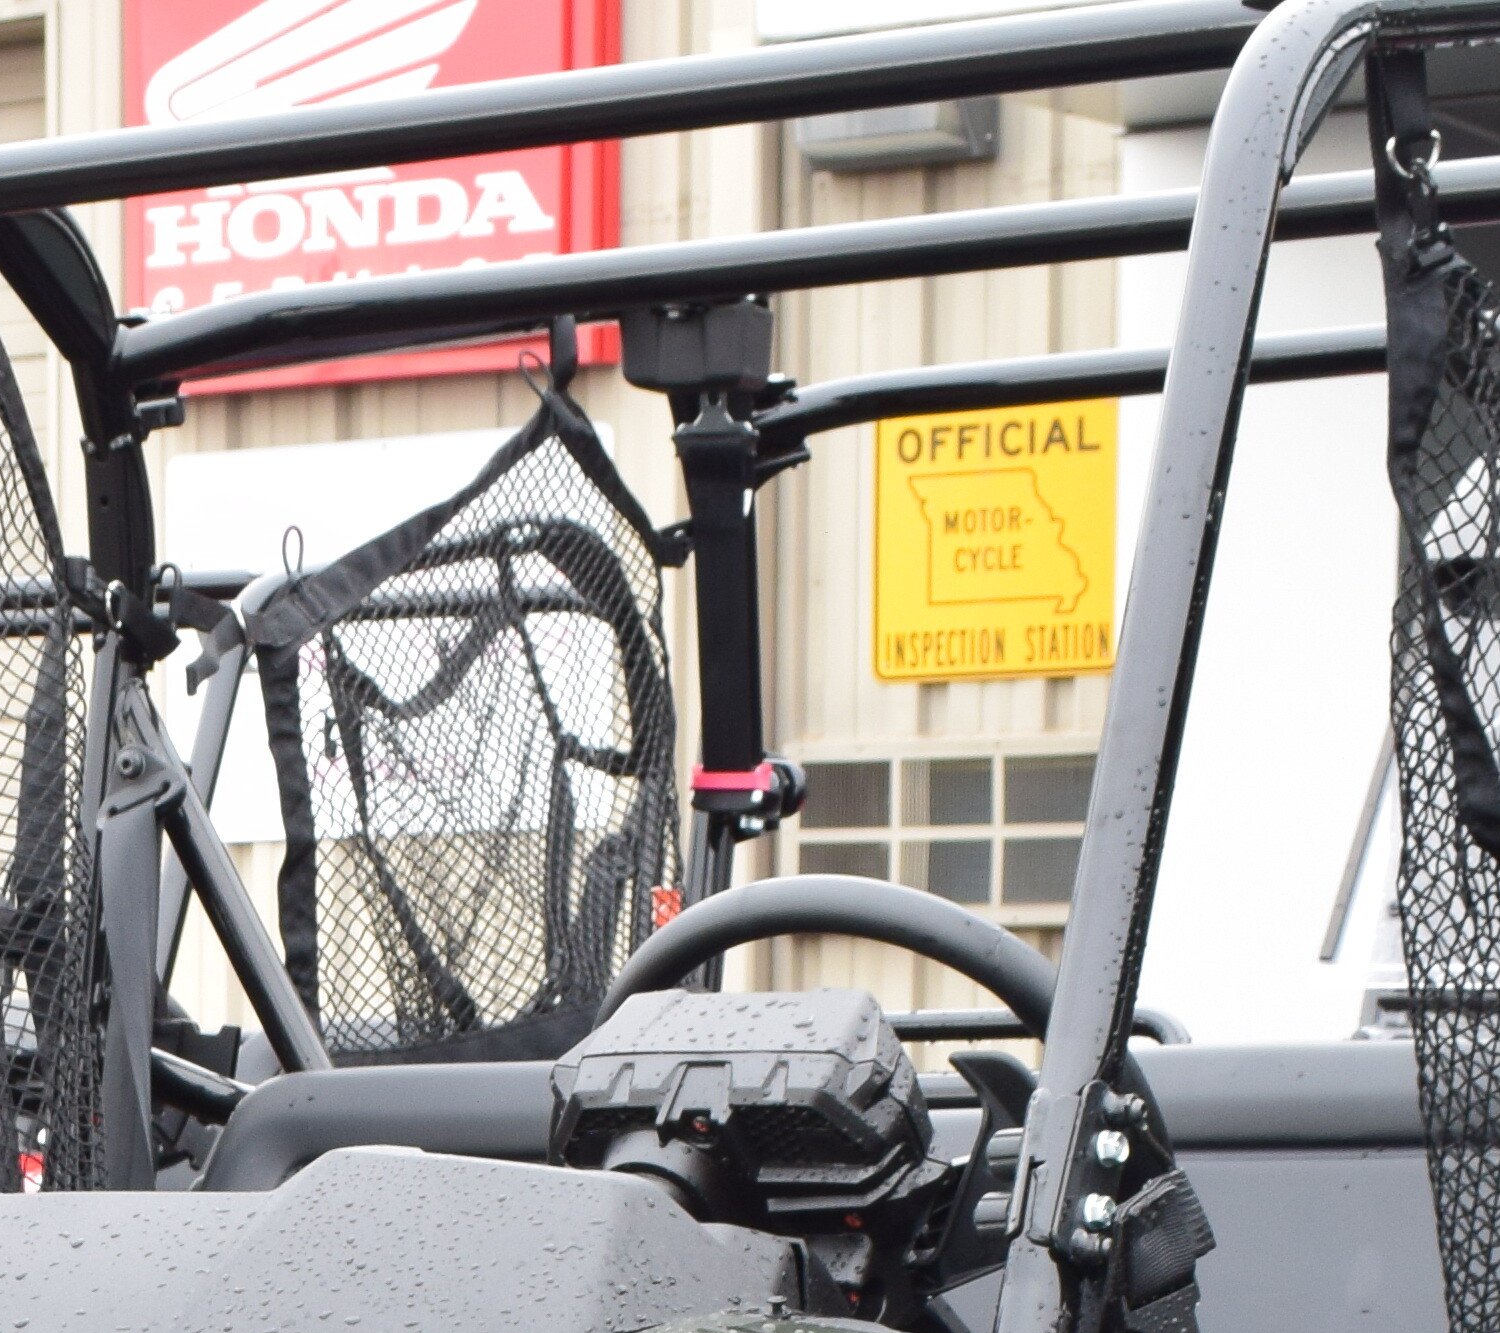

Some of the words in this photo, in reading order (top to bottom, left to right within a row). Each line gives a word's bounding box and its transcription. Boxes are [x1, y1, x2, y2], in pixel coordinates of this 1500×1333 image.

[146, 171, 556, 268] HONDA
[898, 416, 1101, 463] OFFICIAL
[944, 506, 1033, 534] MOTOR-
[954, 544, 1023, 572] CYCLE
[884, 627, 1006, 669] INSPECTION
[1026, 622, 1110, 663] STATION
